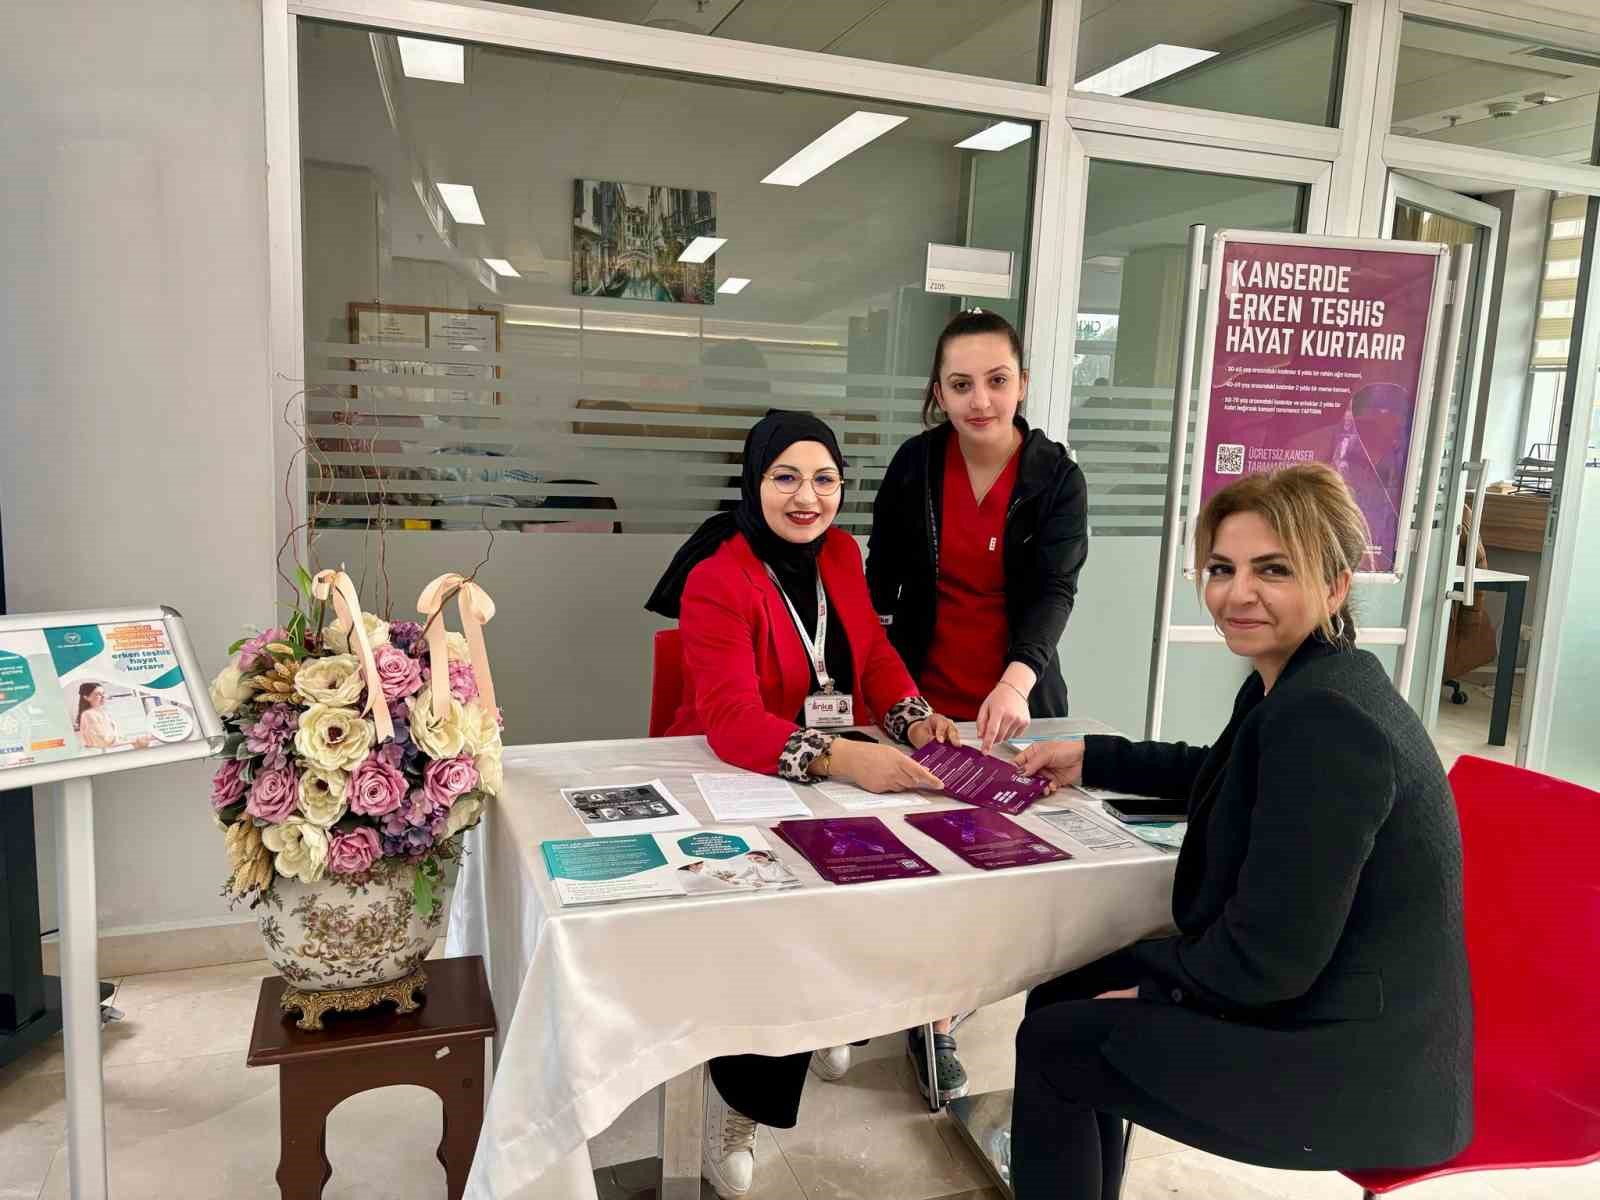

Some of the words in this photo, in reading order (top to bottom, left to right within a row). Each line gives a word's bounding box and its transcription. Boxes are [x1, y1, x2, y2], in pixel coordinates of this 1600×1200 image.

[1231, 259, 1352, 293] KANSERDE
[1228, 293, 1302, 323] ERKEN
[1225, 325, 1295, 355] HAYAT
[1300, 329, 1406, 361] KURTARIR
